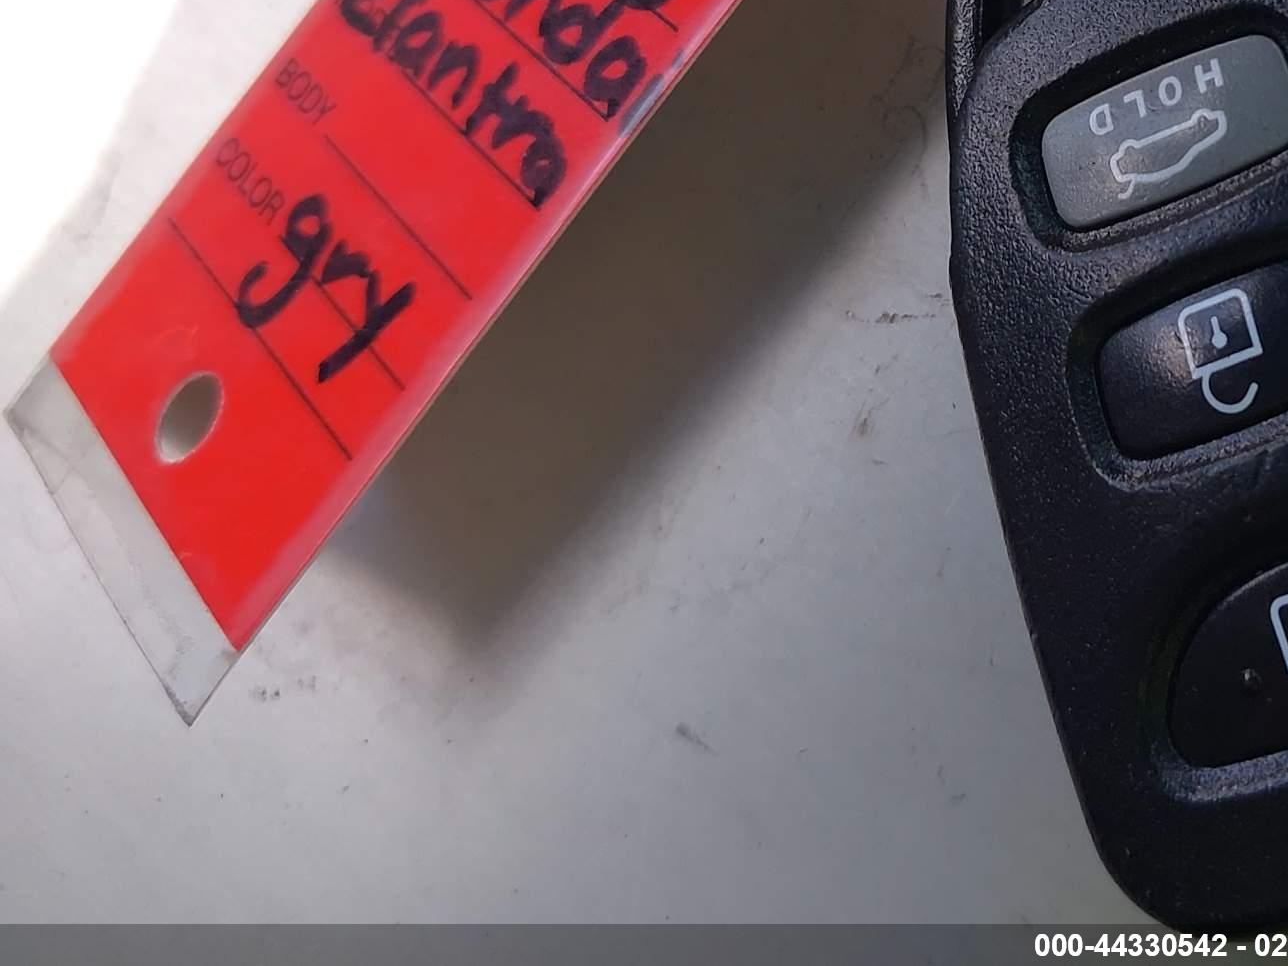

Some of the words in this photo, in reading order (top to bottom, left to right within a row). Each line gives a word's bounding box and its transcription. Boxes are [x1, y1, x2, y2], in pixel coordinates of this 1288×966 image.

[274, 57, 336, 127] BODY
[1088, 57, 1225, 135] HOLD
[216, 137, 286, 221] COLOR
[235, 193, 416, 384] gry
